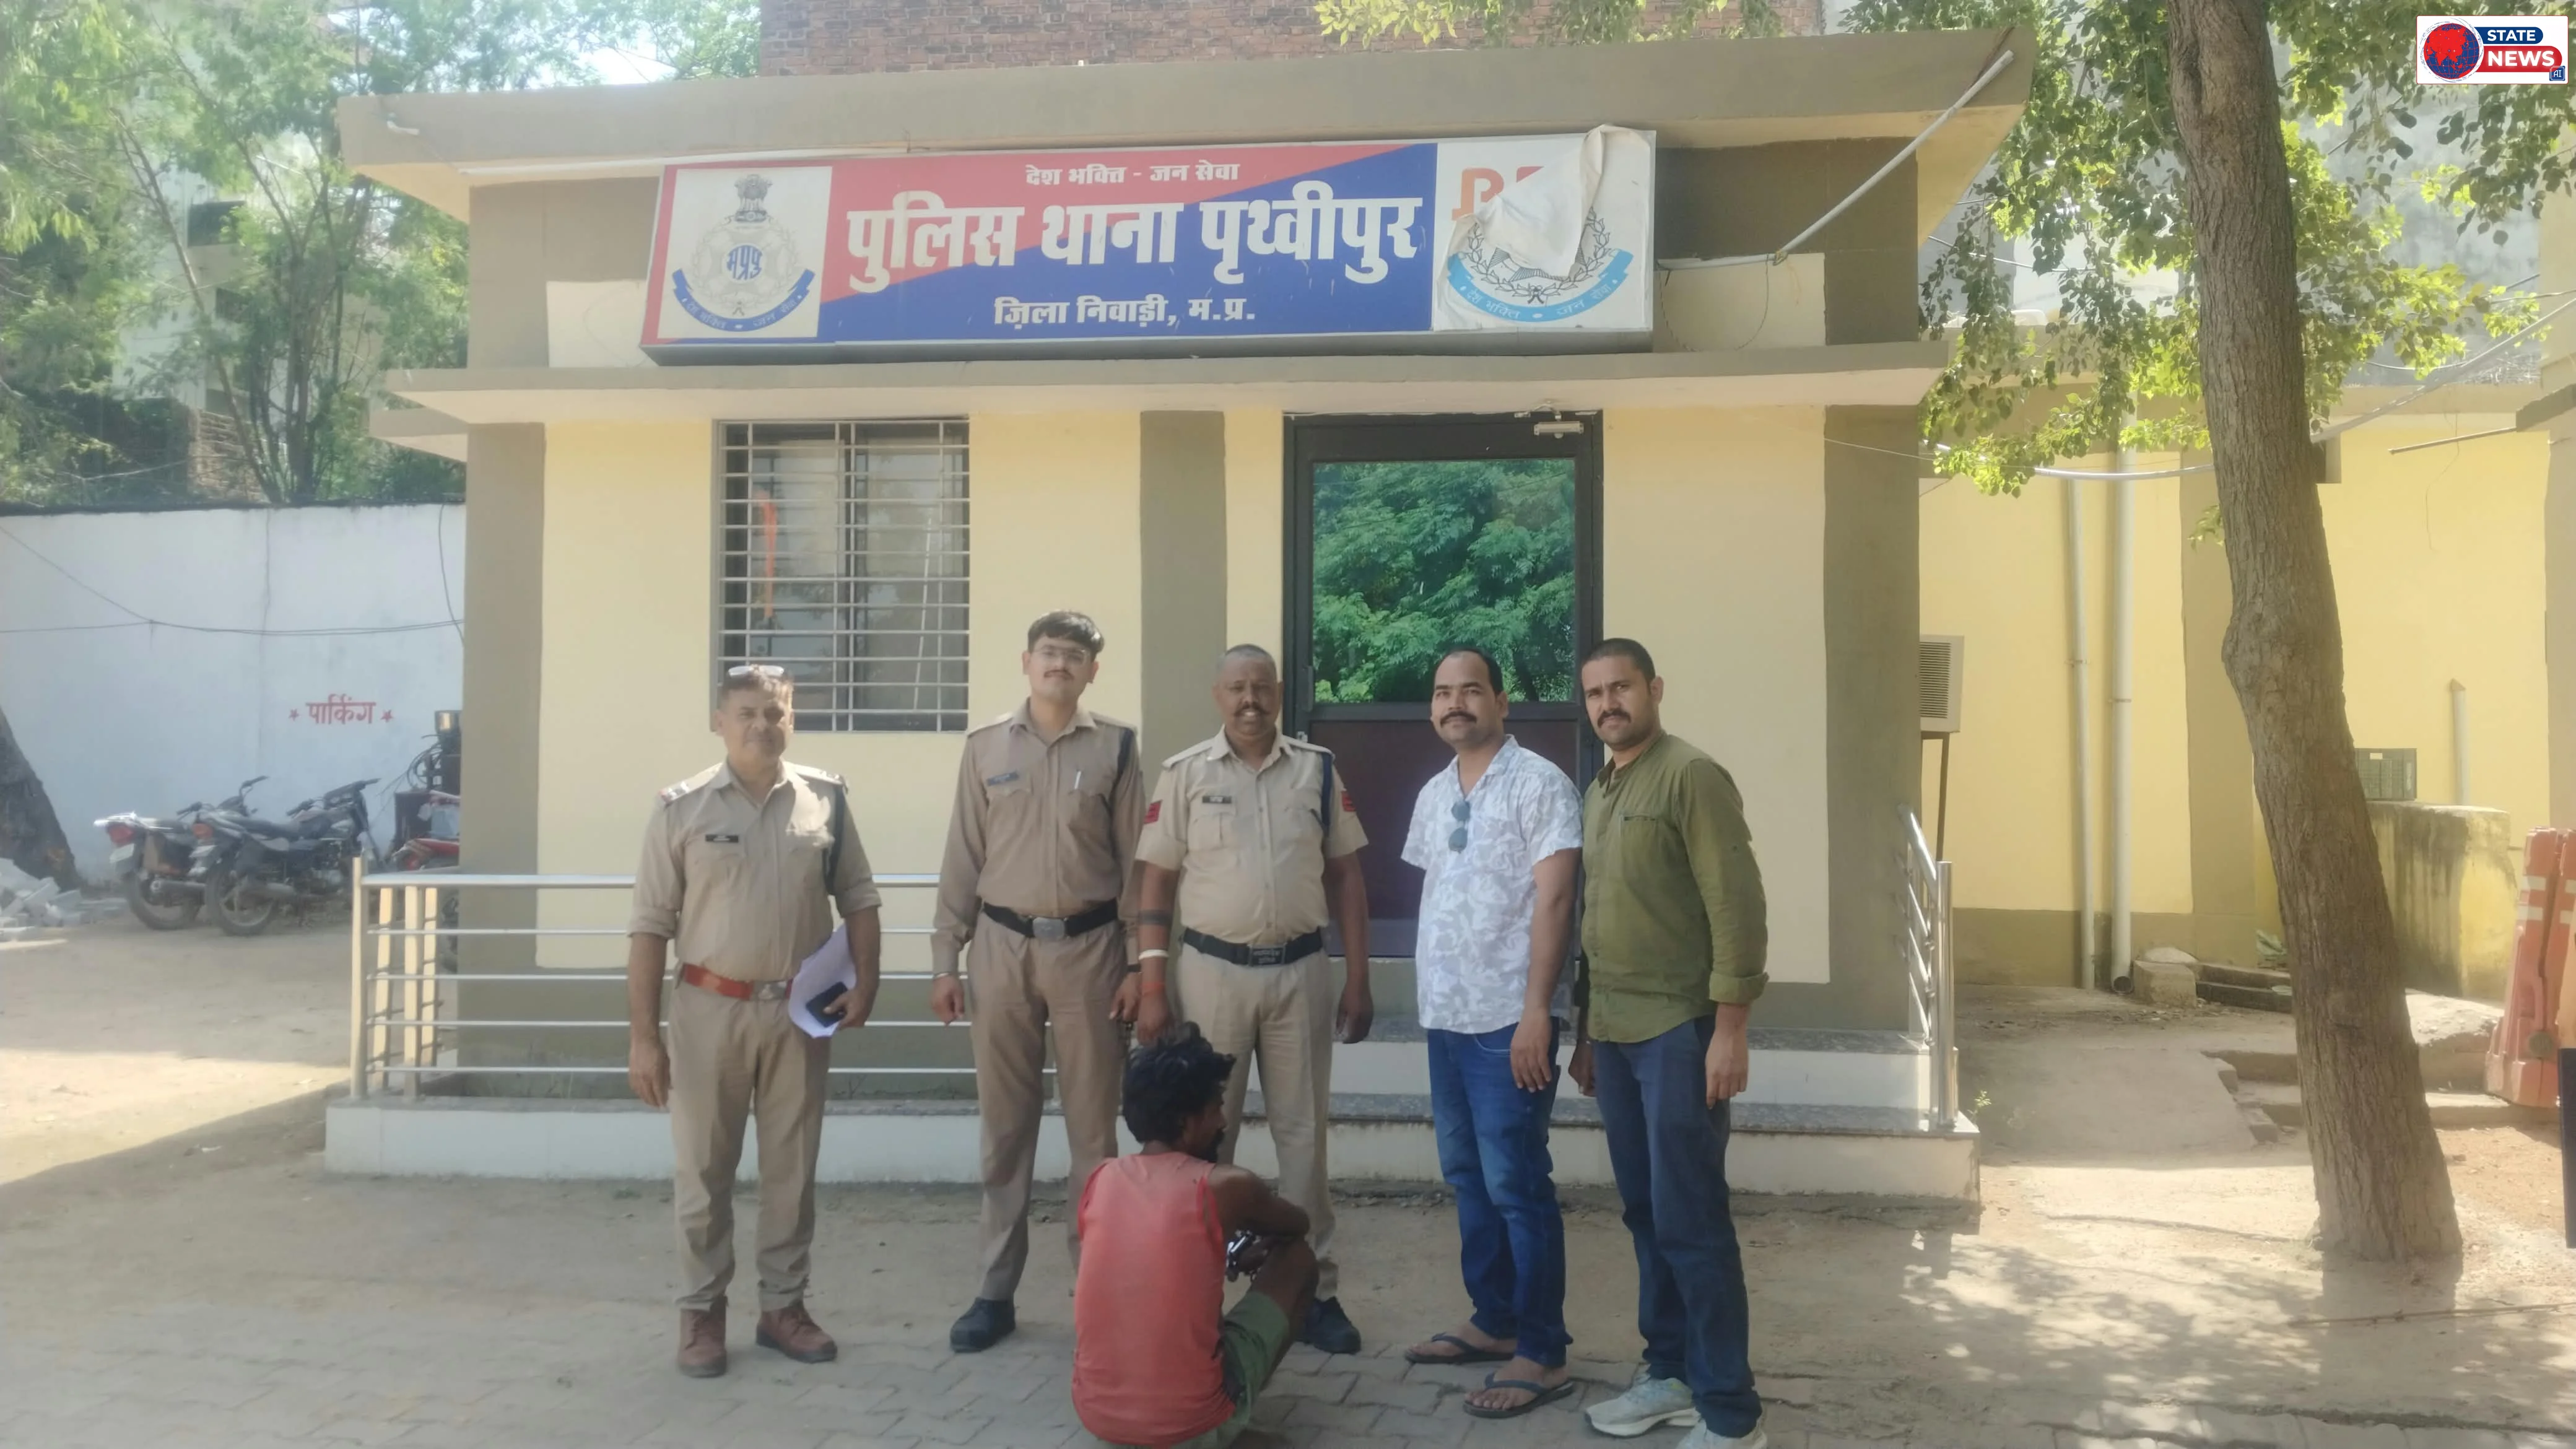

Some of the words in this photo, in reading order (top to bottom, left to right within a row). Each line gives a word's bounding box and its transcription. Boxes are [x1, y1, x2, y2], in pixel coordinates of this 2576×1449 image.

[1025, 164, 1063, 185] देश
[1068, 163, 1128, 184] भक्ति
[1149, 165, 1190, 181] जन
[1195, 159, 1240, 181] सेवा
[846, 190, 1025, 294] पुलिस
[1041, 202, 1184, 265] थाना
[1199, 180, 1423, 284] पृथ्वीपुर
[994, 297, 1070, 329] ज़िला
[1076, 294, 1177, 327] निवाड़ी,
[305, 694, 376, 724] पार्किंग
